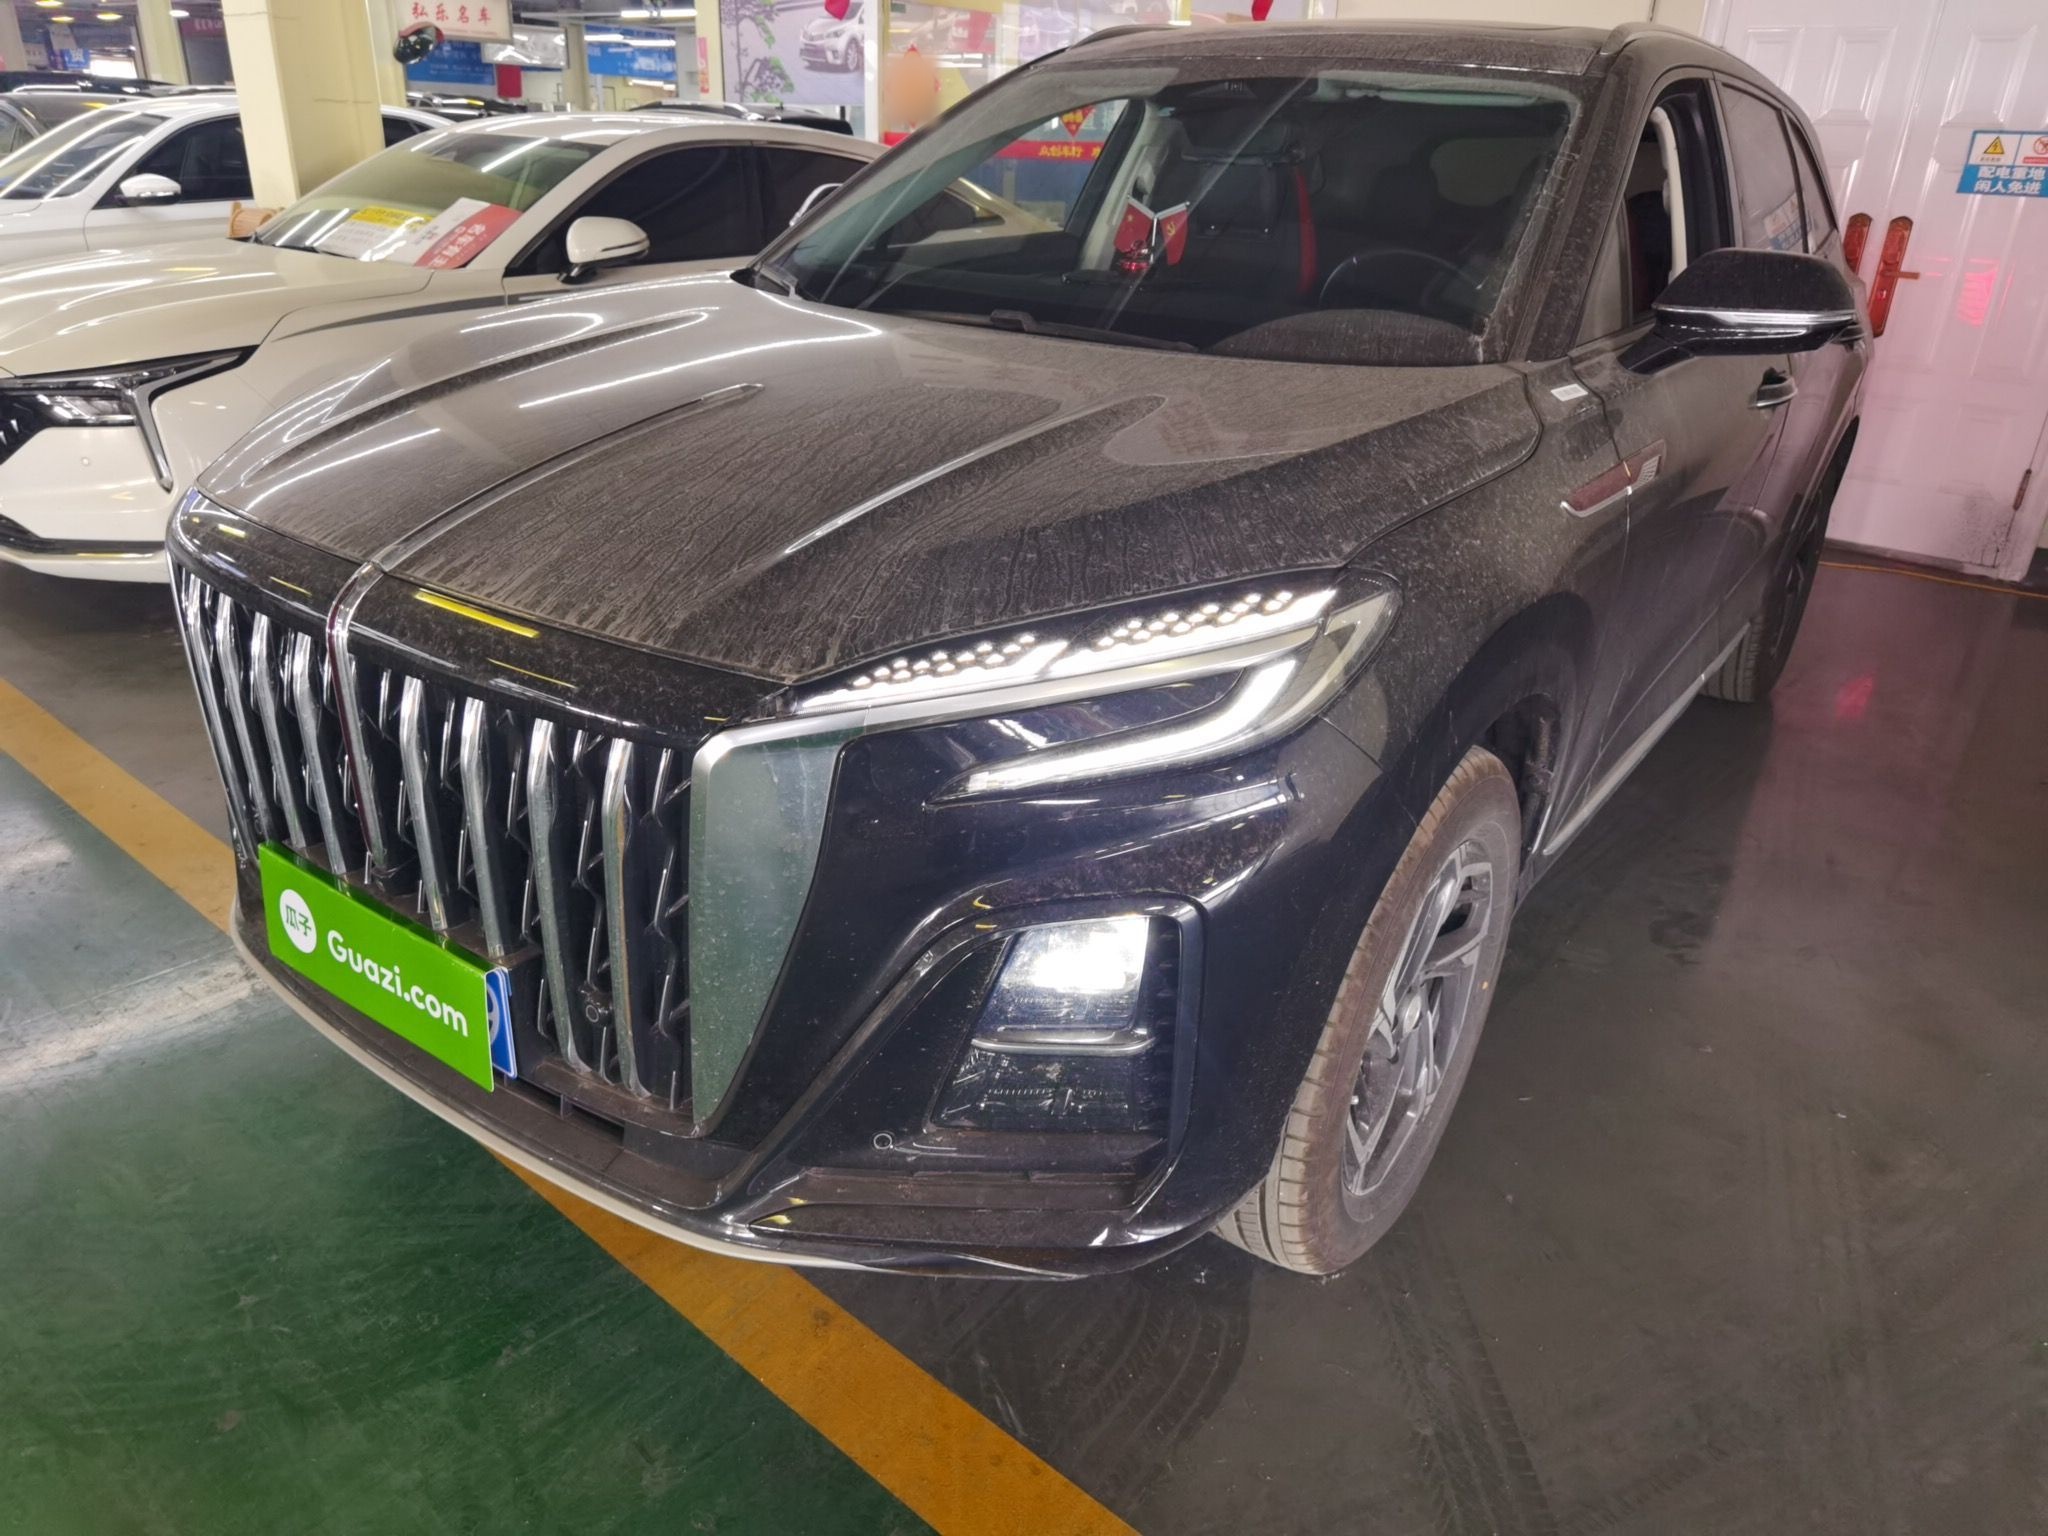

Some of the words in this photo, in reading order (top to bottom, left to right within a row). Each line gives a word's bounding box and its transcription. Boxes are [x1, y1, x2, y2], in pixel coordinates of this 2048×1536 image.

[1979, 166, 2045, 180] 配电重地
[1974, 180, 2041, 194] 闲人免进
[285, 903, 312, 937] 瓜子
[327, 930, 468, 1037] Guazi.com
